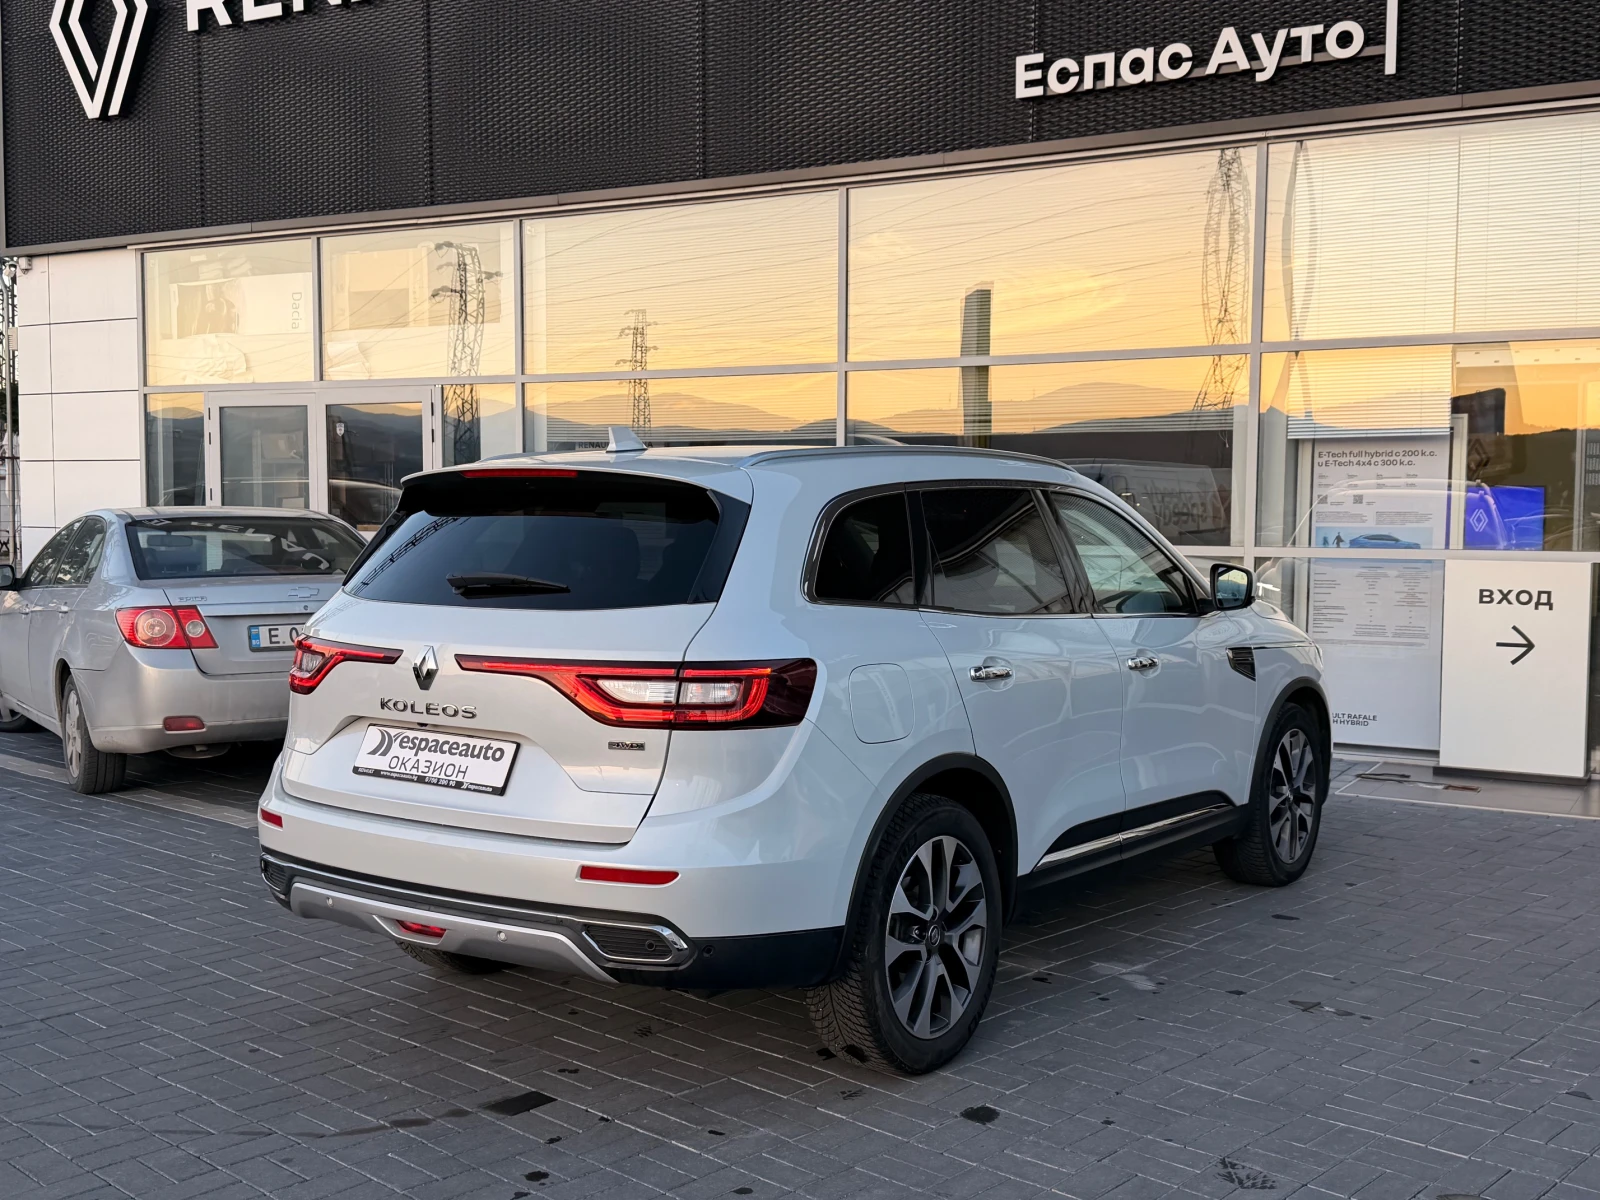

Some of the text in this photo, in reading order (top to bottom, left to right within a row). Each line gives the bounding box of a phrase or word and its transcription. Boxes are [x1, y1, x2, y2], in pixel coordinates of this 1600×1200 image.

[1015, 20, 1365, 99] Еспас Ауто
[292, 292, 302, 329] Dacia
[578, 441, 609, 449] RENAU
[1349, 450, 1363, 458] full
[1364, 450, 1393, 459] hybrid
[1401, 449, 1420, 457] 200
[1324, 459, 1355, 467] E-Tech
[1380, 459, 1398, 467] 300
[380, 697, 477, 719] KOLEOS
[1339, 719, 1369, 727] HYBRID
[1347, 713, 1378, 721] RAFALE
[399, 734, 505, 762] espaceauto
[388, 755, 469, 780] ОКАЗИОН
